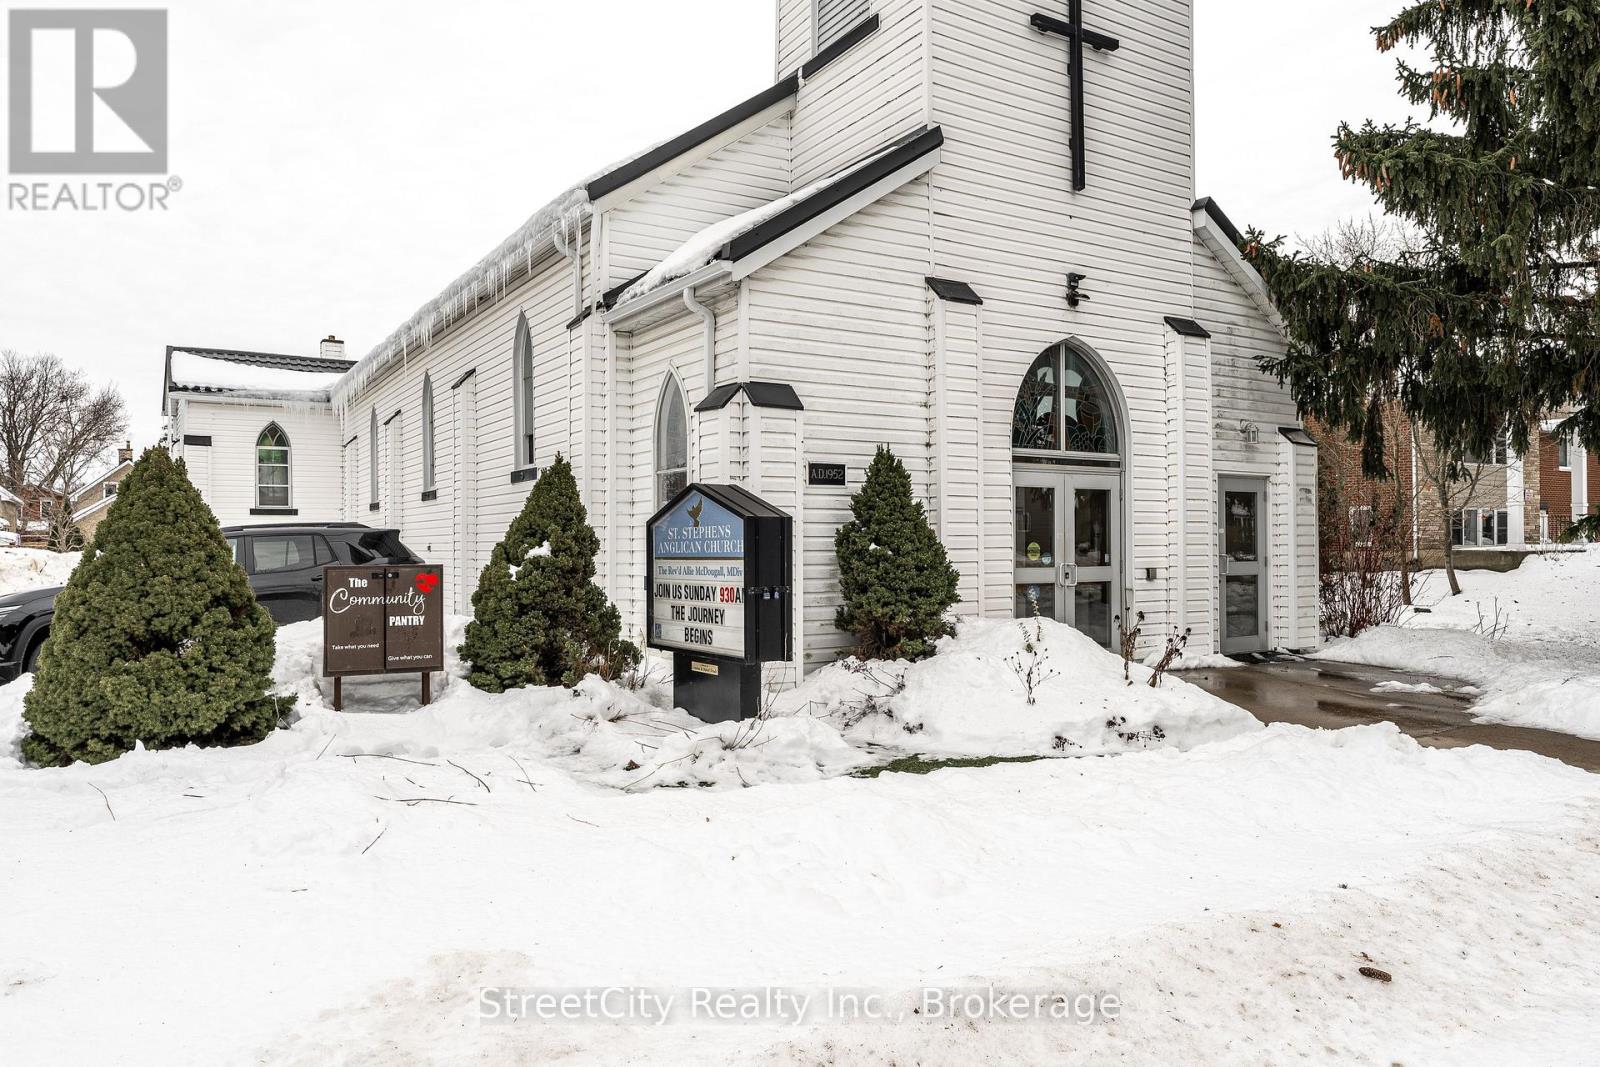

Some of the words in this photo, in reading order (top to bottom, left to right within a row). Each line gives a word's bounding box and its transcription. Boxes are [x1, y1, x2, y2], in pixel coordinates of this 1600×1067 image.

[668, 527, 680, 540] ST.
[682, 524, 731, 539] STEPHENS
[658, 540, 702, 554] ANGLICAN
[704, 539, 744, 553] CHURCH
[658, 565, 667, 575] The
[668, 566, 682, 575] Rev'd
[682, 566, 694, 576] Allie
[695, 566, 726, 579] McDougall,
[348, 577, 368, 588] The
[329, 586, 426, 615] Community
[655, 583, 671, 598] JOIN
[672, 584, 682, 599] US
[684, 584, 717, 602] SUNDAY
[389, 615, 425, 626] PANTRY
[670, 605, 685, 621] THE
[687, 607, 725, 625] JOURNEY
[684, 627, 713, 645] BEGINS
